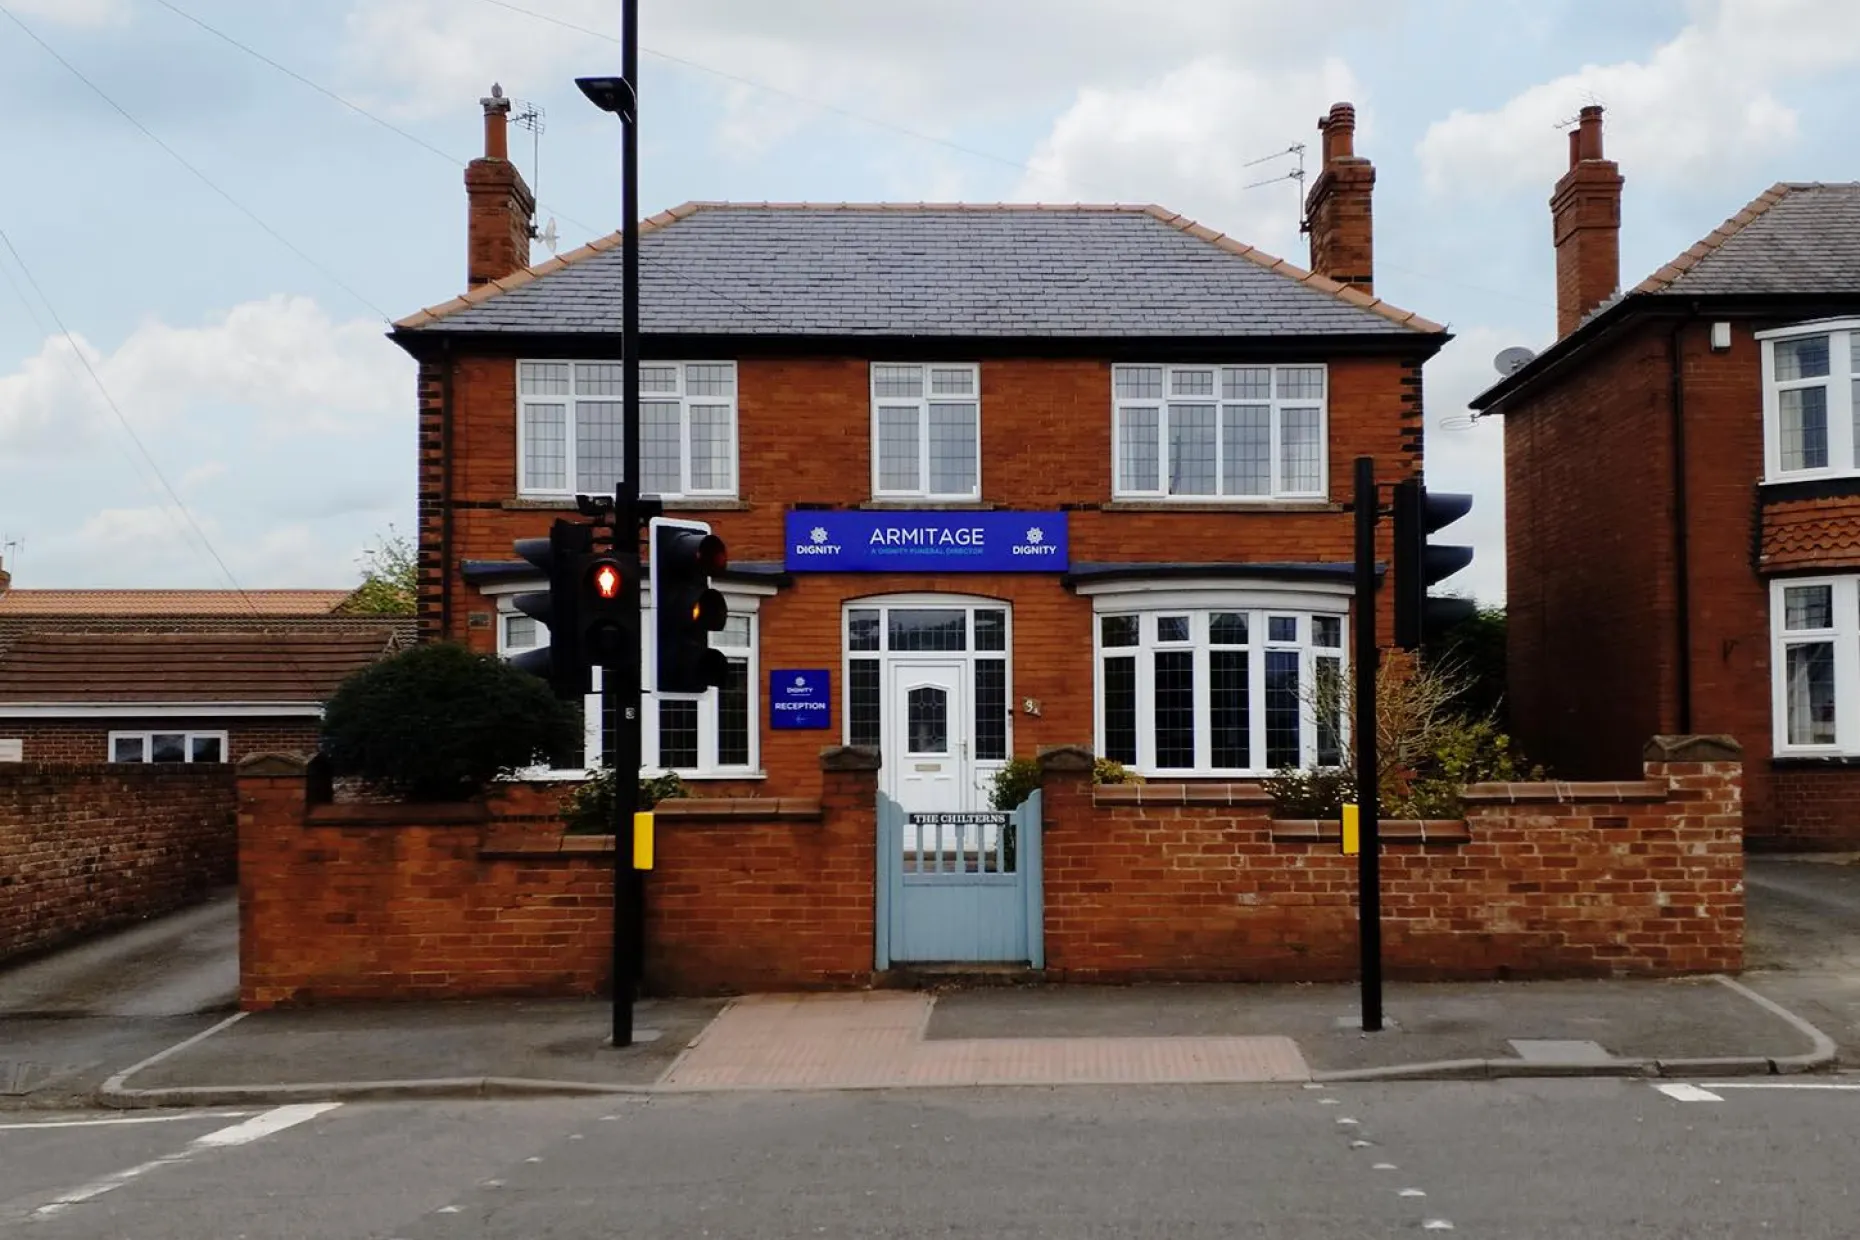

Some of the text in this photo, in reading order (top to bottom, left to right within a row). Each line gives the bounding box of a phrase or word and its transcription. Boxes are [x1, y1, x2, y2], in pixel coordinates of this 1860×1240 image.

[869, 528, 985, 545] ARMITAGE
[796, 545, 842, 555] DIGNITY
[1012, 545, 1057, 555] DIGNITY
[774, 702, 826, 710] RECEPTION
[913, 814, 1006, 824] THE CHILTERNS
